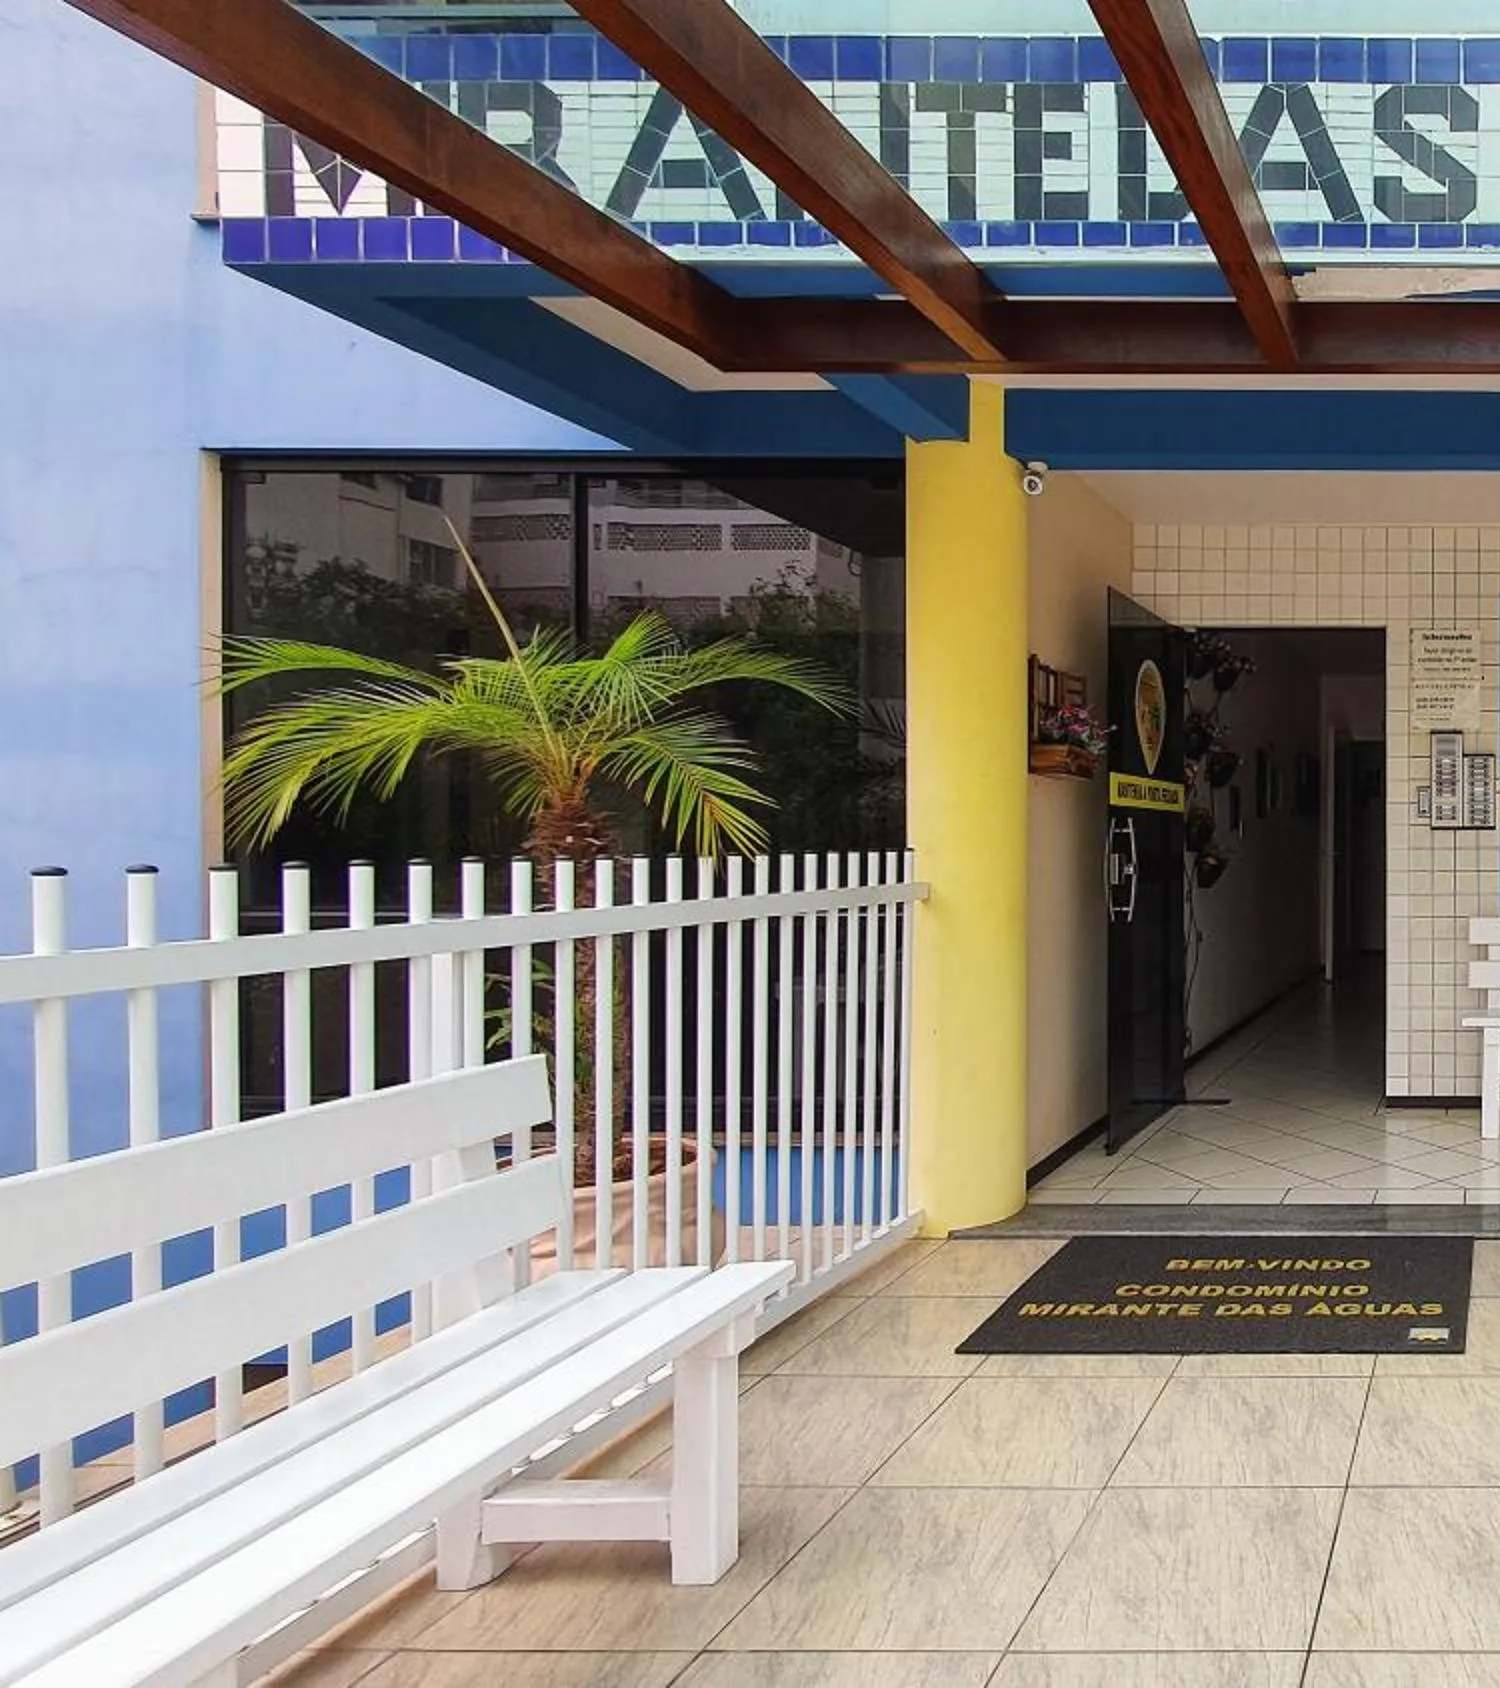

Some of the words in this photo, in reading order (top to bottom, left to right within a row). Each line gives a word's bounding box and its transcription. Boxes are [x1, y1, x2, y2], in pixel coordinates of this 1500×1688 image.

[263, 80, 1089, 221] MRATE
[1018, 1303, 1203, 1317] MIRANTE
[1215, 1303, 1293, 1316] DAS
